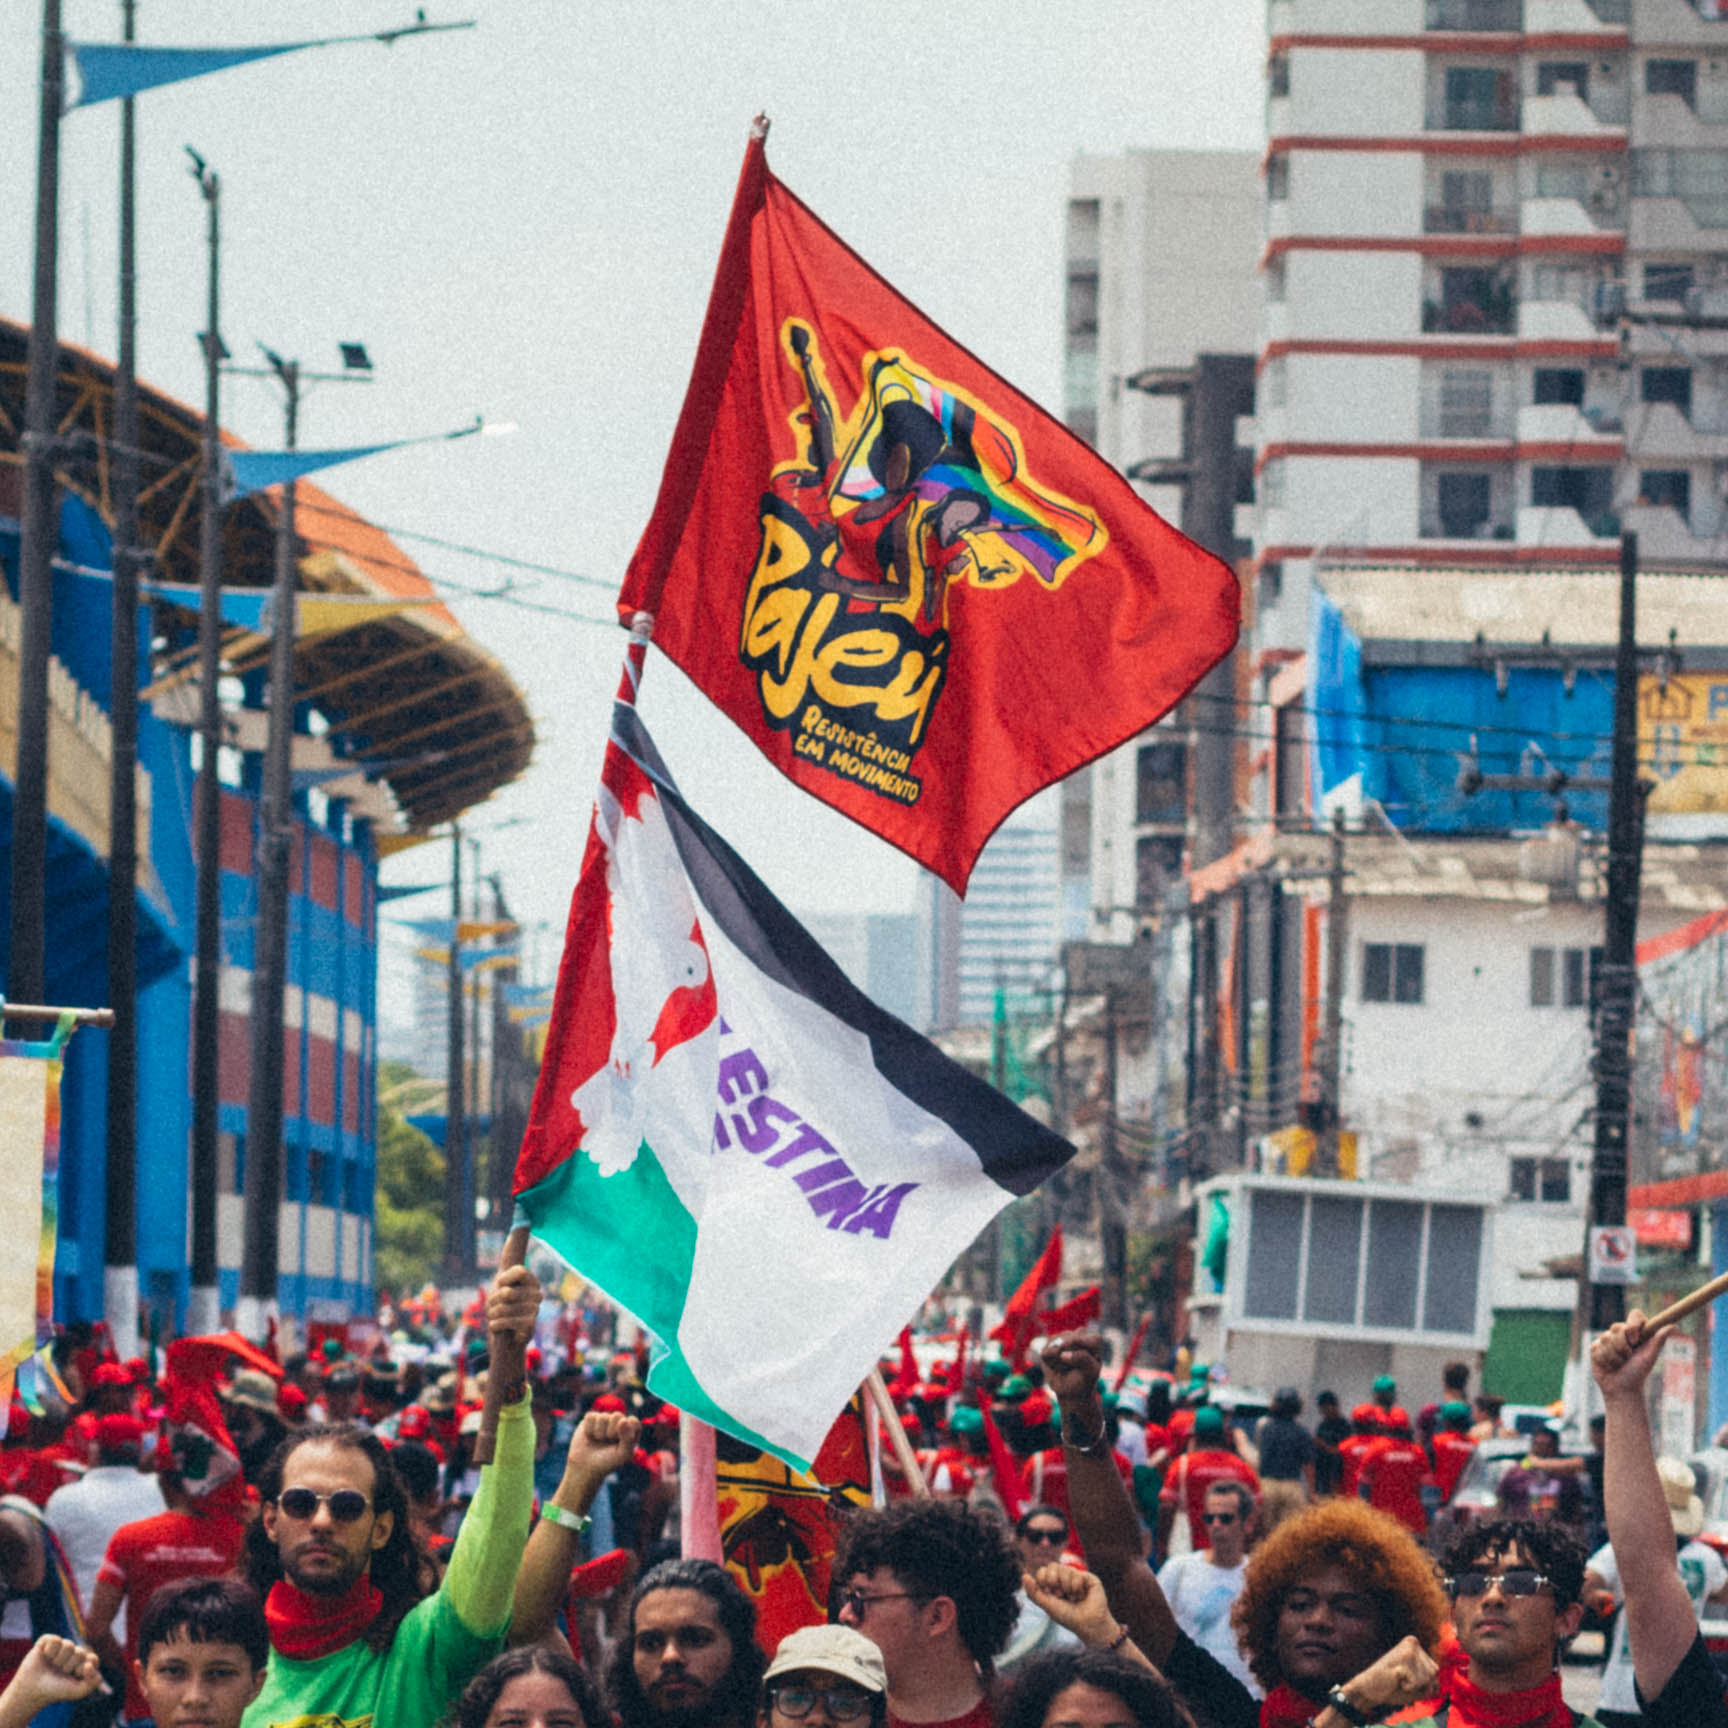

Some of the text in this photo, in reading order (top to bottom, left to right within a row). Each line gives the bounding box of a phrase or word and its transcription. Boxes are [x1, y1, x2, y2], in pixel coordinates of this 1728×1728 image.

[795, 733, 920, 802] EM MOVIMENTO
[800, 703, 912, 774] RESISTÊNCIA
